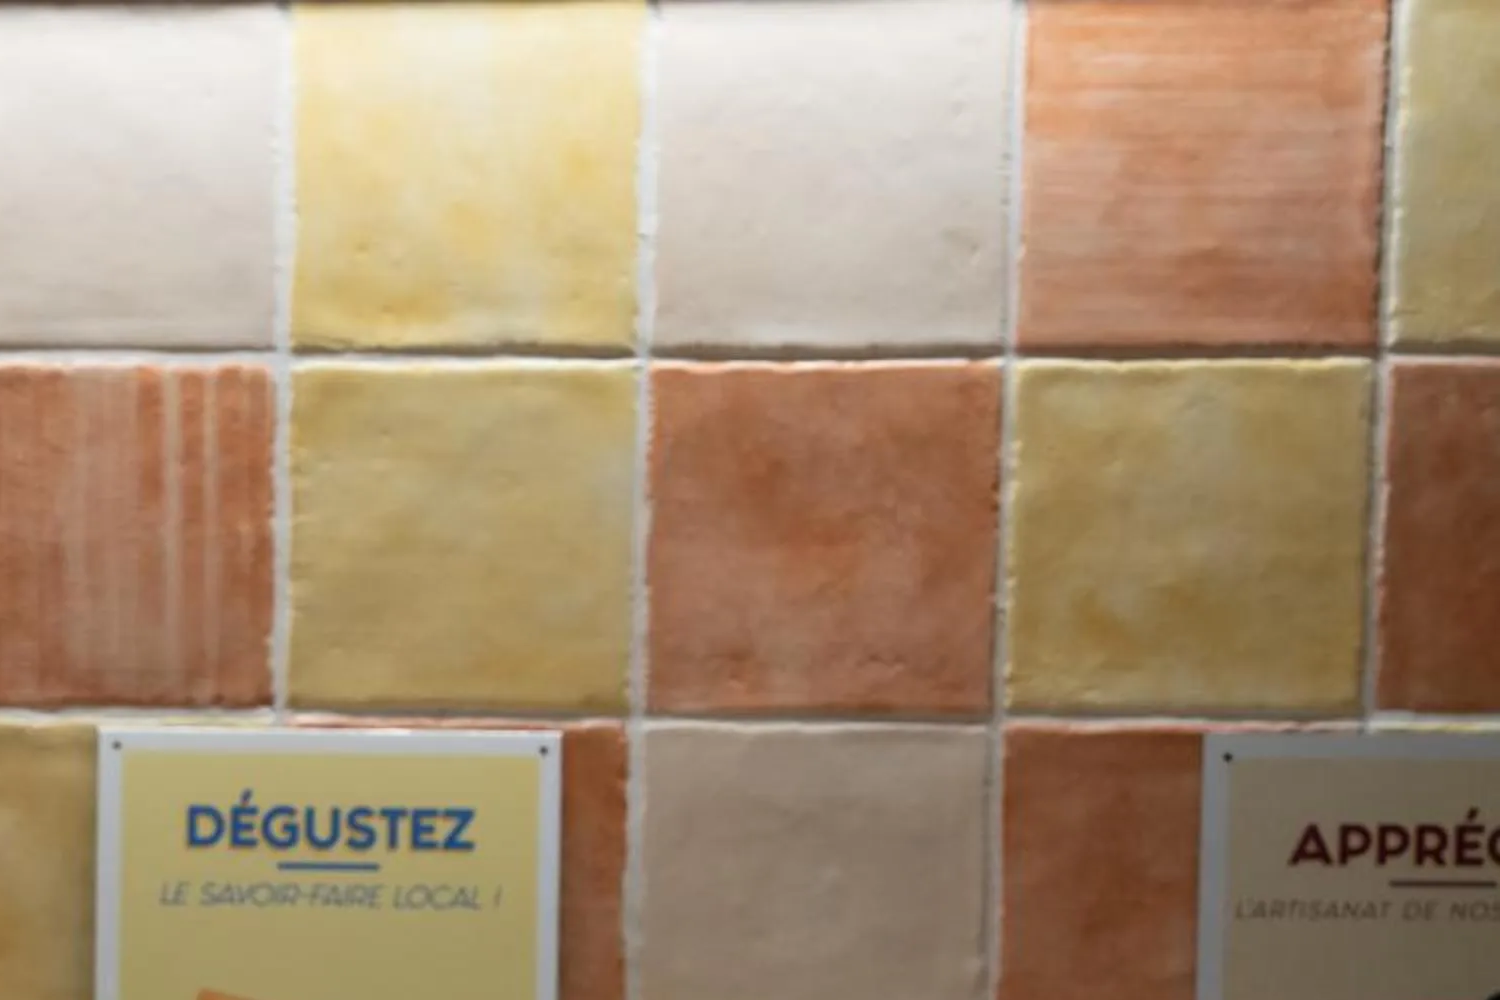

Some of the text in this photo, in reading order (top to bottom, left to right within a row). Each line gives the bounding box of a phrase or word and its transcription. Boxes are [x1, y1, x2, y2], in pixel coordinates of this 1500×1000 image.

[185, 788, 476, 852] DÉGUSTEZ
[158, 880, 188, 907] LE
[198, 880, 385, 910] SAVOIR-FAIRE
[393, 884, 483, 912] LOCAL
[1401, 900, 1438, 923] DE
